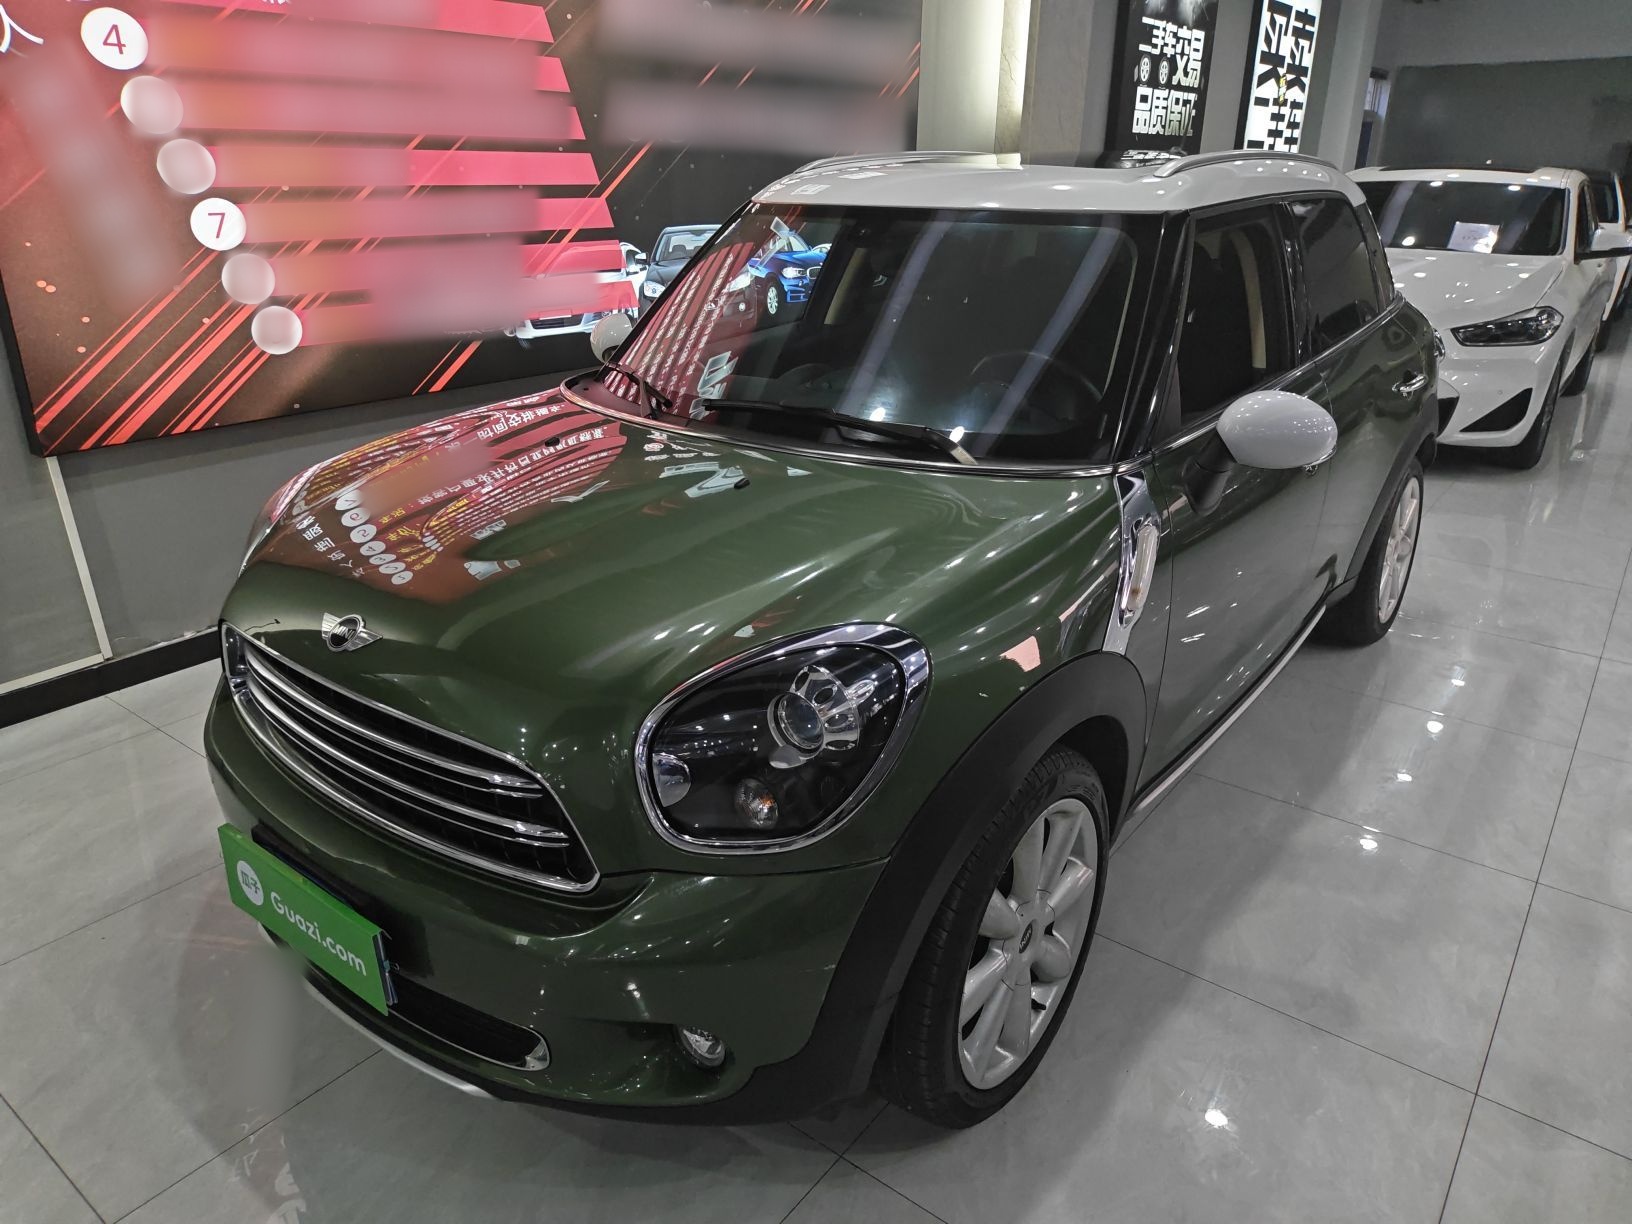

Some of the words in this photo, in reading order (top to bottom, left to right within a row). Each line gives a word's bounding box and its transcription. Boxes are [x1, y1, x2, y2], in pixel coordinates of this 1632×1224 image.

[102, 24, 126, 54] 4
[1138, 16, 1206, 88] 二手车交易
[1131, 86, 1199, 137] 品质保证
[208, 212, 227, 239] 7
[332, 623, 356, 641] MINI
[269, 891, 368, 977] Guazi.com
